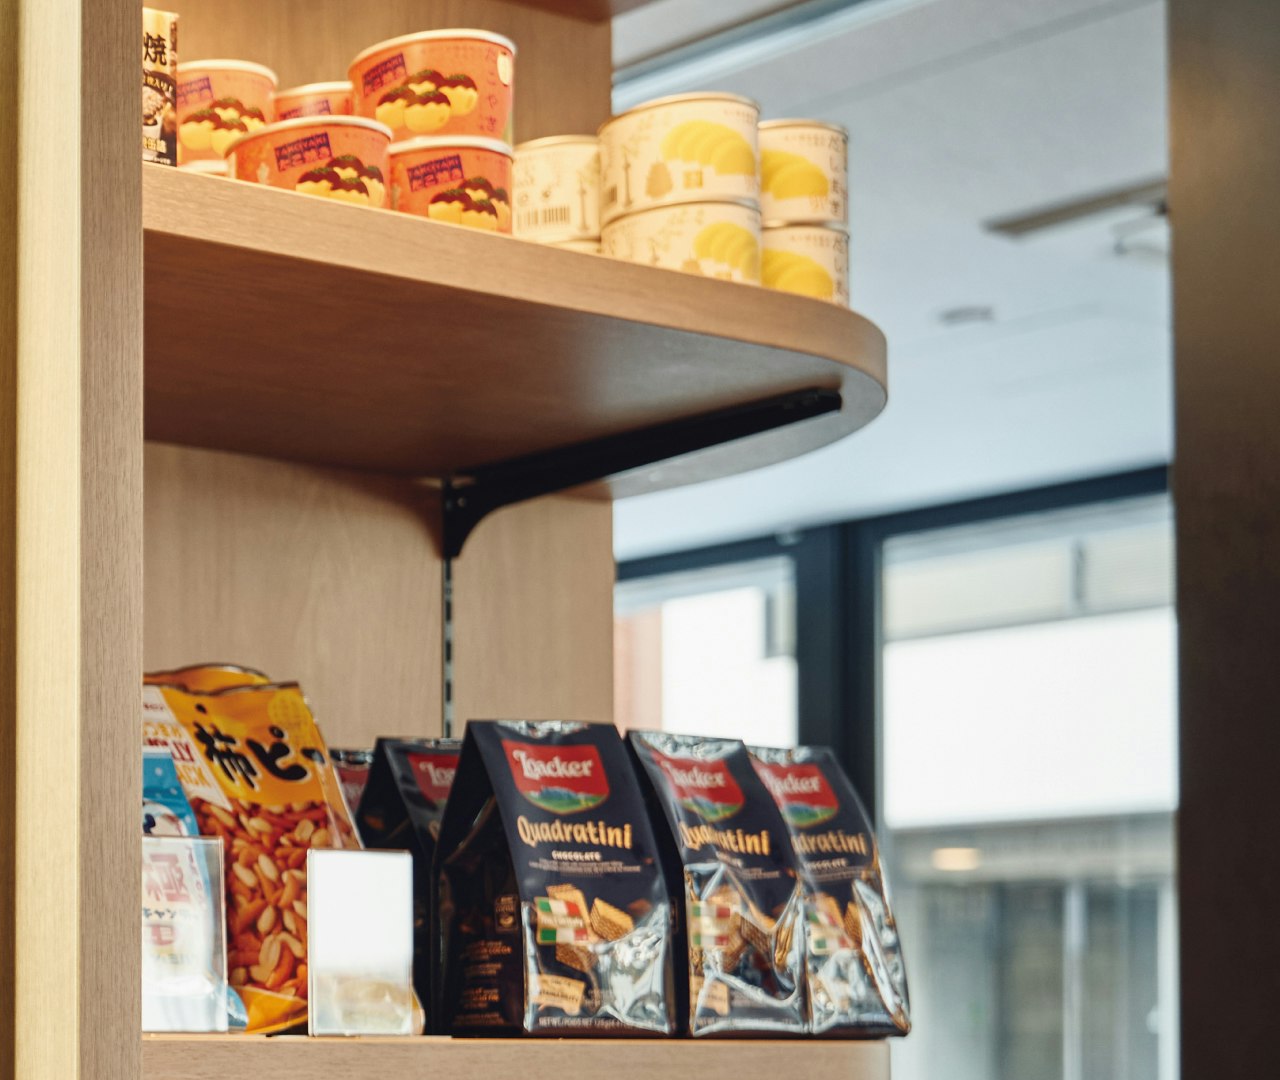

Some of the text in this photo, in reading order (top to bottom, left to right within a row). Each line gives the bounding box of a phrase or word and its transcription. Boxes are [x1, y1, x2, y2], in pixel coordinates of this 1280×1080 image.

[513, 749, 593, 779] Loacker
[517, 815, 632, 849] Quadratini
[552, 850, 602, 861] CHOCOLATE
